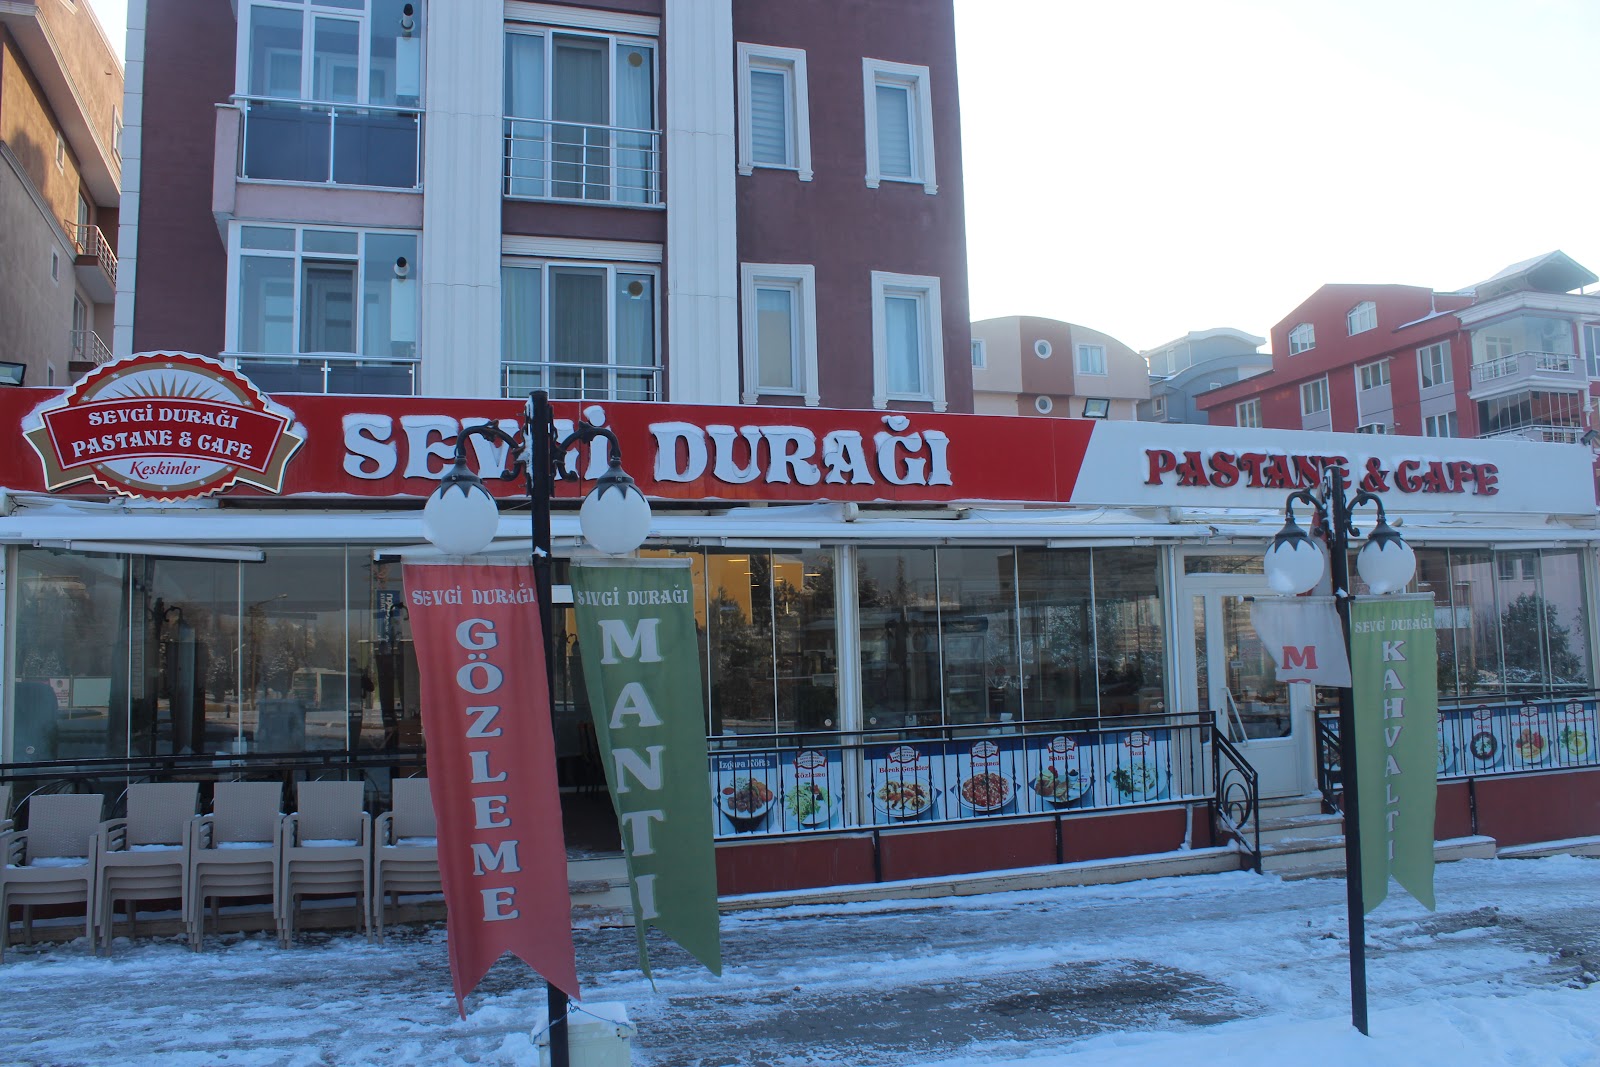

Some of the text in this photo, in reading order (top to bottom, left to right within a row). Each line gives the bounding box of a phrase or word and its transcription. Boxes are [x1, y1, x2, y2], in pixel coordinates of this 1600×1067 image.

[88, 404, 239, 430] SEVGİ DURAĞI
[71, 430, 253, 461] PASTANE & CAFE
[648, 414, 954, 487] DURAĞI
[130, 461, 201, 480] Keskinler
[1144, 448, 1500, 496] PASTANE & CAFE
[411, 583, 536, 607] SEVGİ DURAĞI
[627, 584, 689, 606] DURAĞI
[455, 617, 521, 922] GÖZLEME
[597, 617, 666, 921] MANTI
[1381, 640, 1407, 862] KAHVALTI
